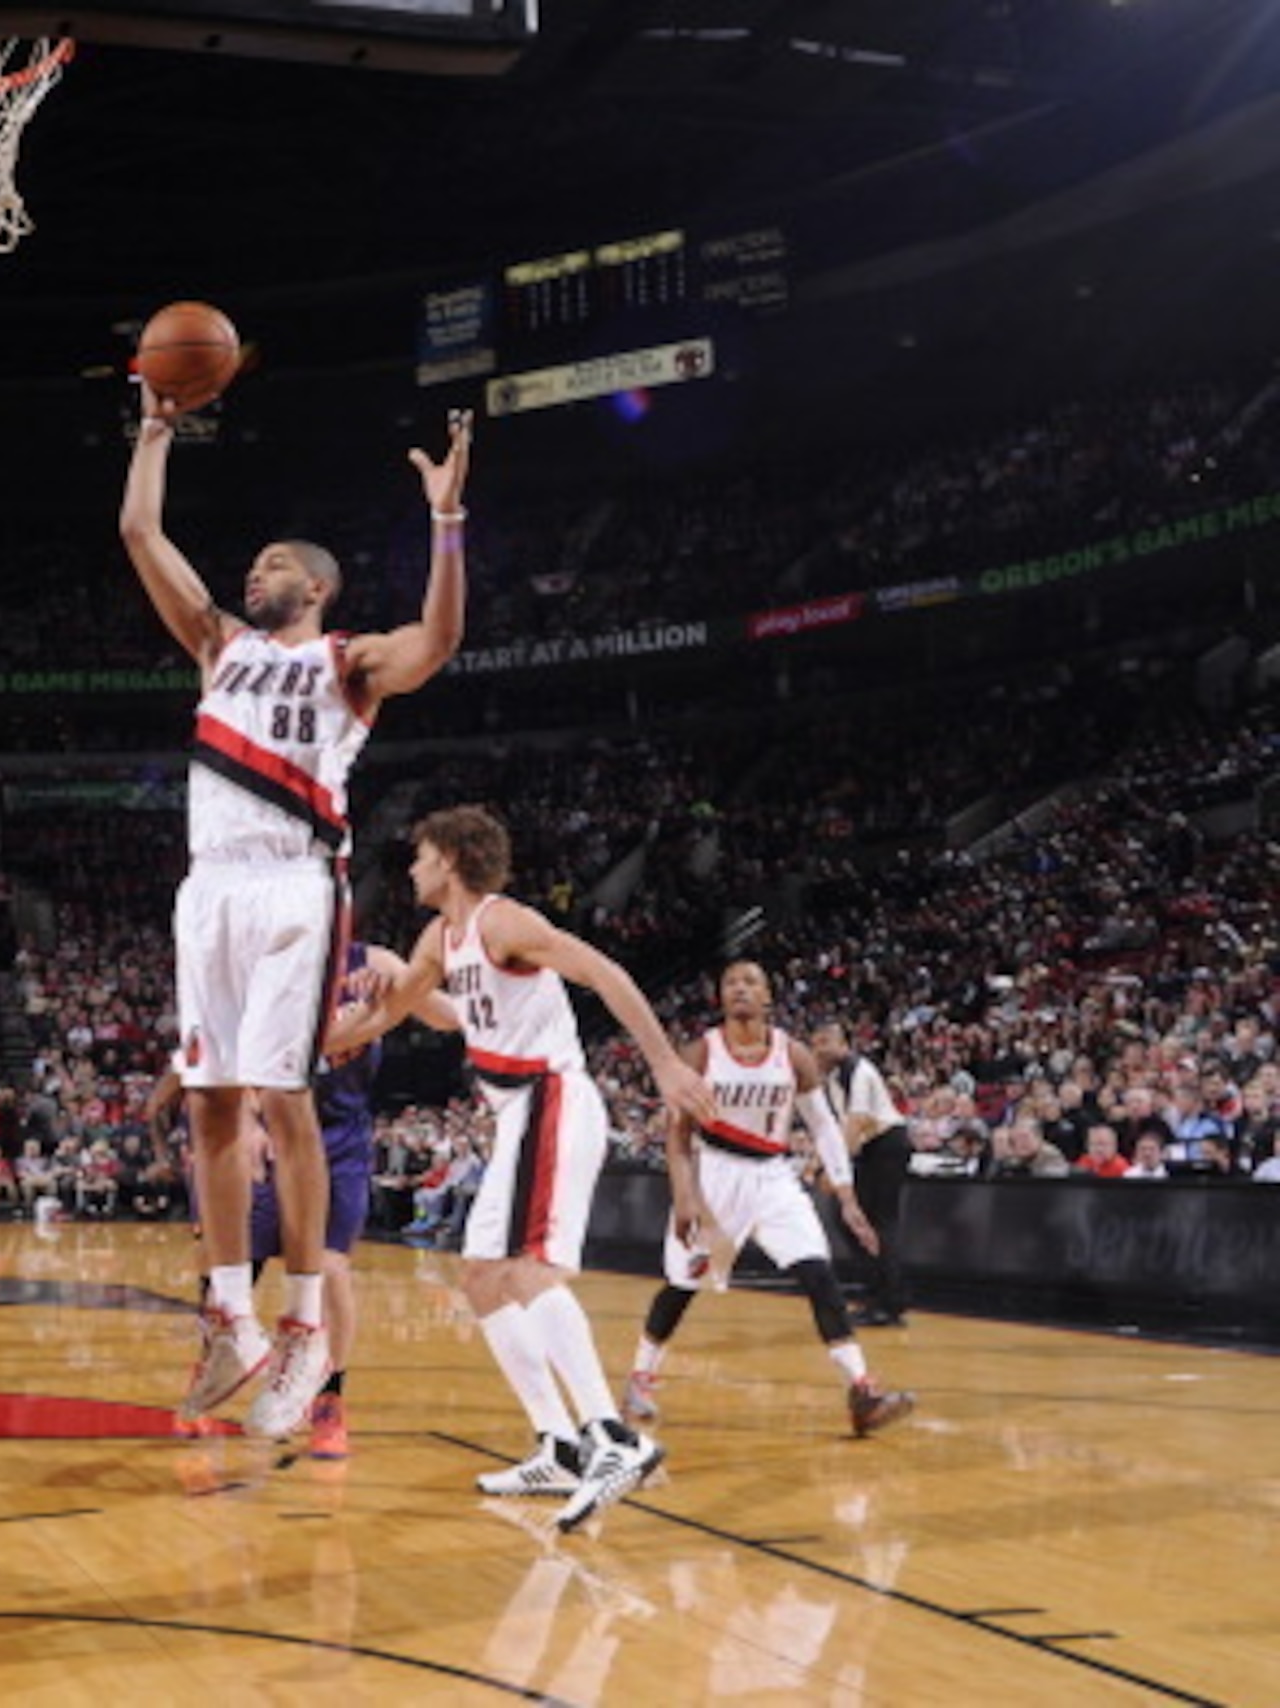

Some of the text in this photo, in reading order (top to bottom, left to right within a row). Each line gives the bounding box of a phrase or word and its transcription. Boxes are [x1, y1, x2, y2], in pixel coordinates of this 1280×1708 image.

[1132, 511, 1219, 556] GAME
[529, 639, 562, 666] AT
[568, 638, 589, 660] A
[593, 620, 707, 656] MILLION
[11, 672, 84, 693] GAME
[271, 703, 317, 745] 88
[468, 993, 498, 1032] 42
